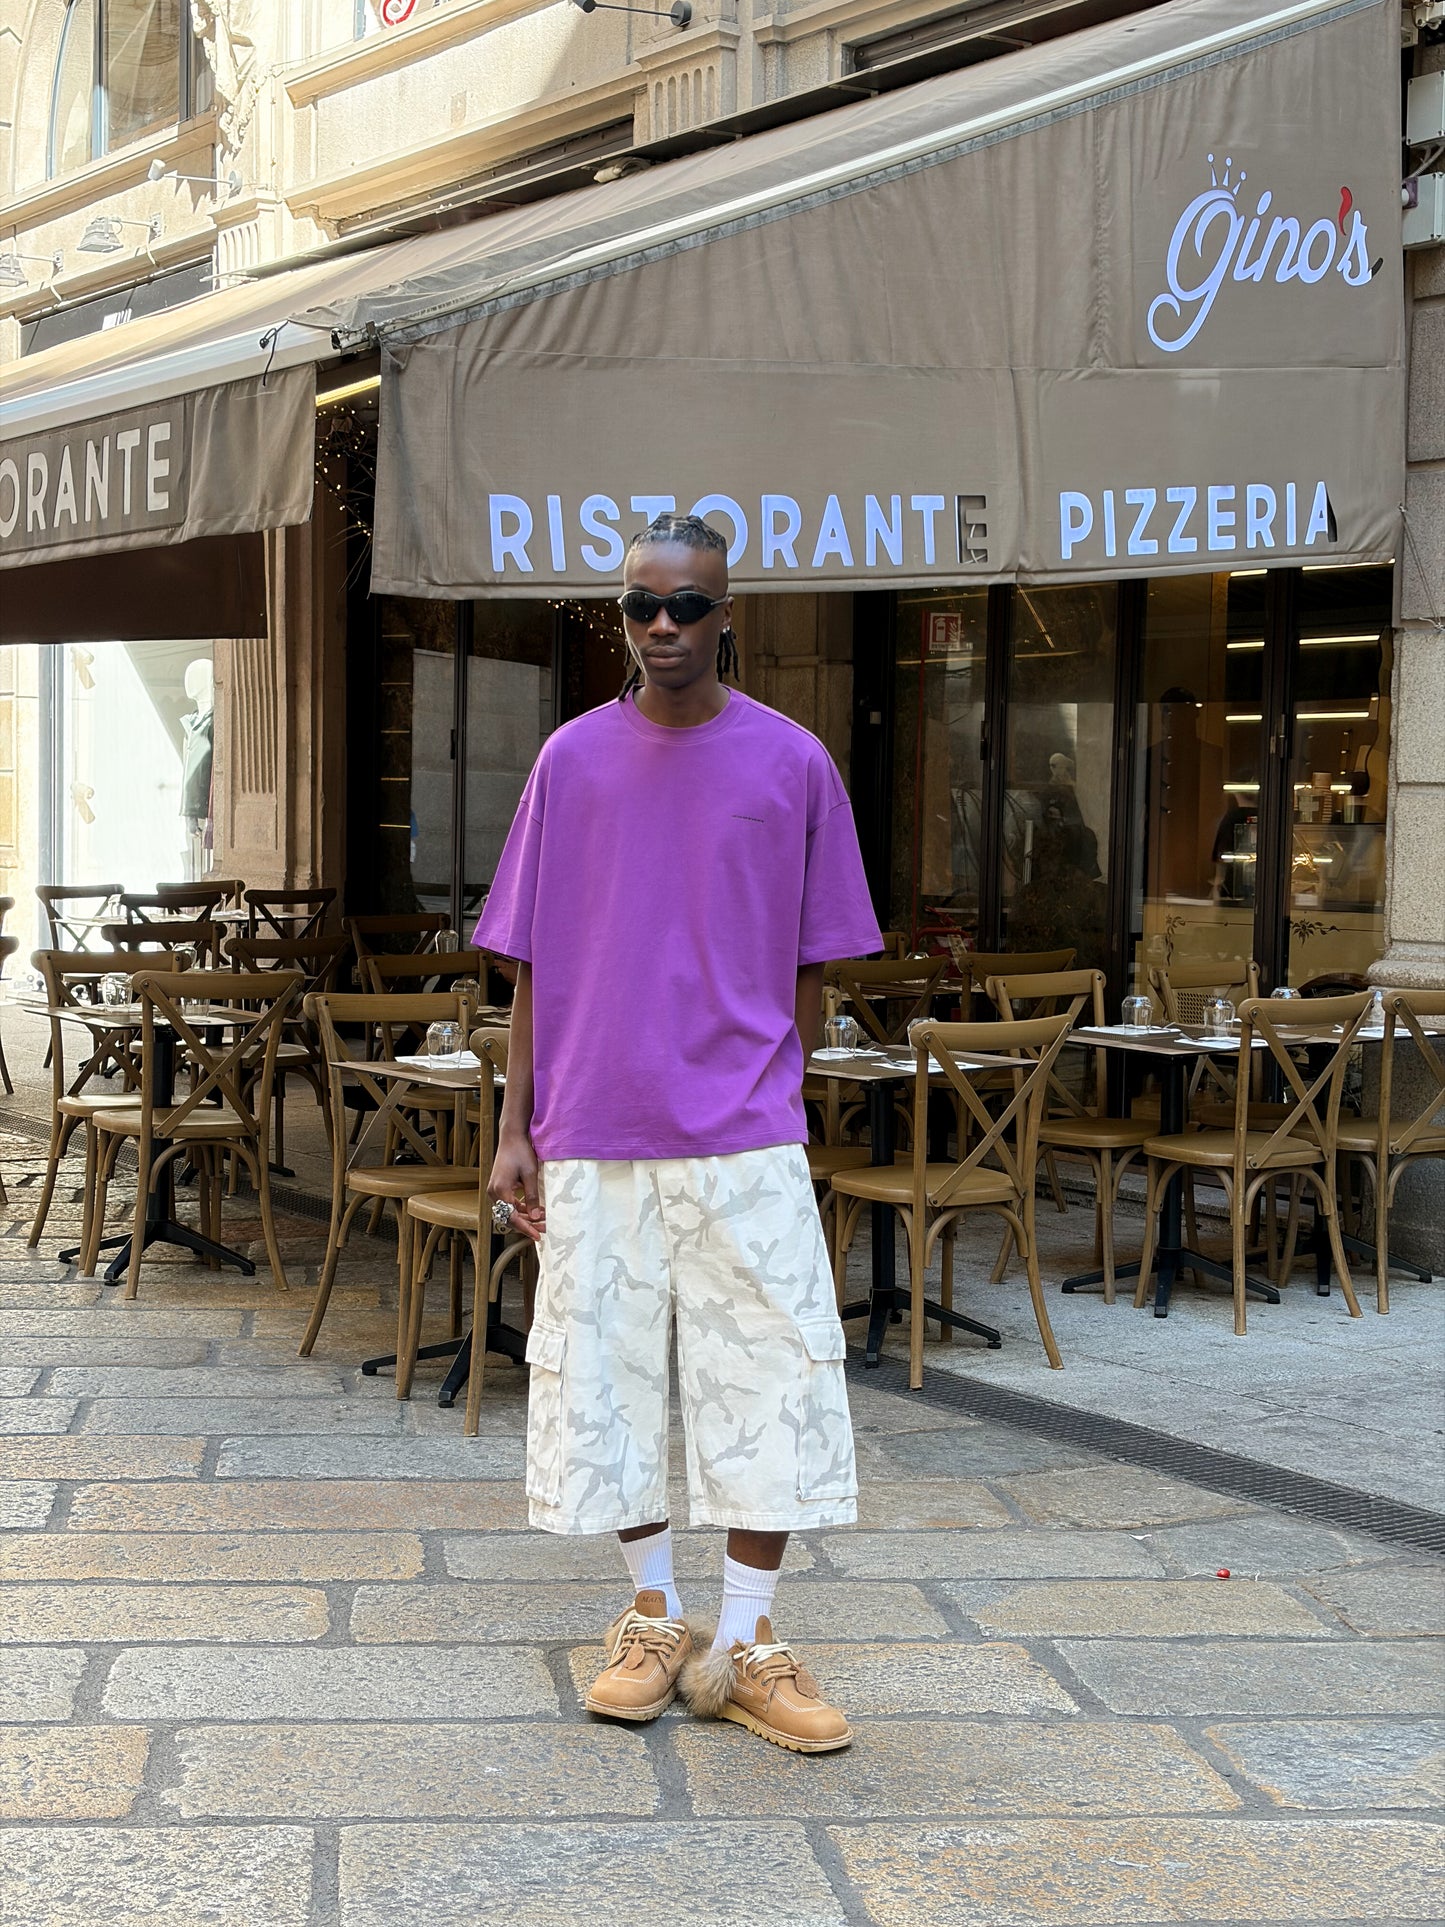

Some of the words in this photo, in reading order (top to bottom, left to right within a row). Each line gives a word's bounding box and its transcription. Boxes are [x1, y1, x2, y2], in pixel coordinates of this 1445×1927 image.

[0, 421, 171, 538] ORANTE
[488, 493, 988, 573] RISTORANTE
[1059, 481, 1338, 560] PIZZERIA
